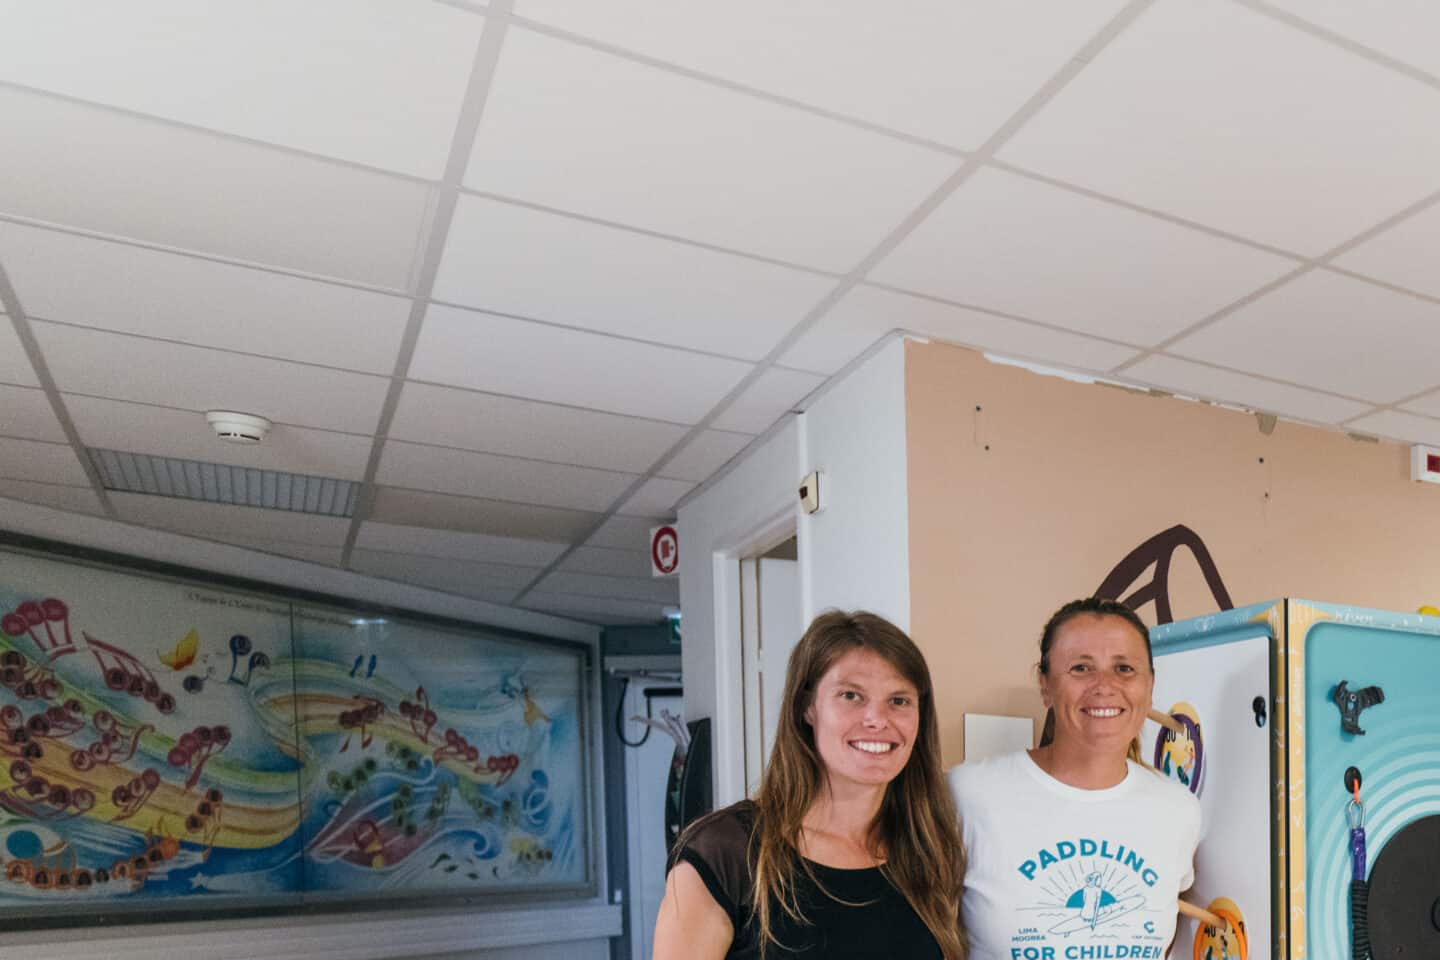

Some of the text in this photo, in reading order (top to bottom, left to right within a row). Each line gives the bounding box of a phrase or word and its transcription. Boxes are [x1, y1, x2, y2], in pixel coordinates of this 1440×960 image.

[1017, 838, 1159, 887] PADDLING
[1011, 944, 1163, 960] FOR CHILDREN
